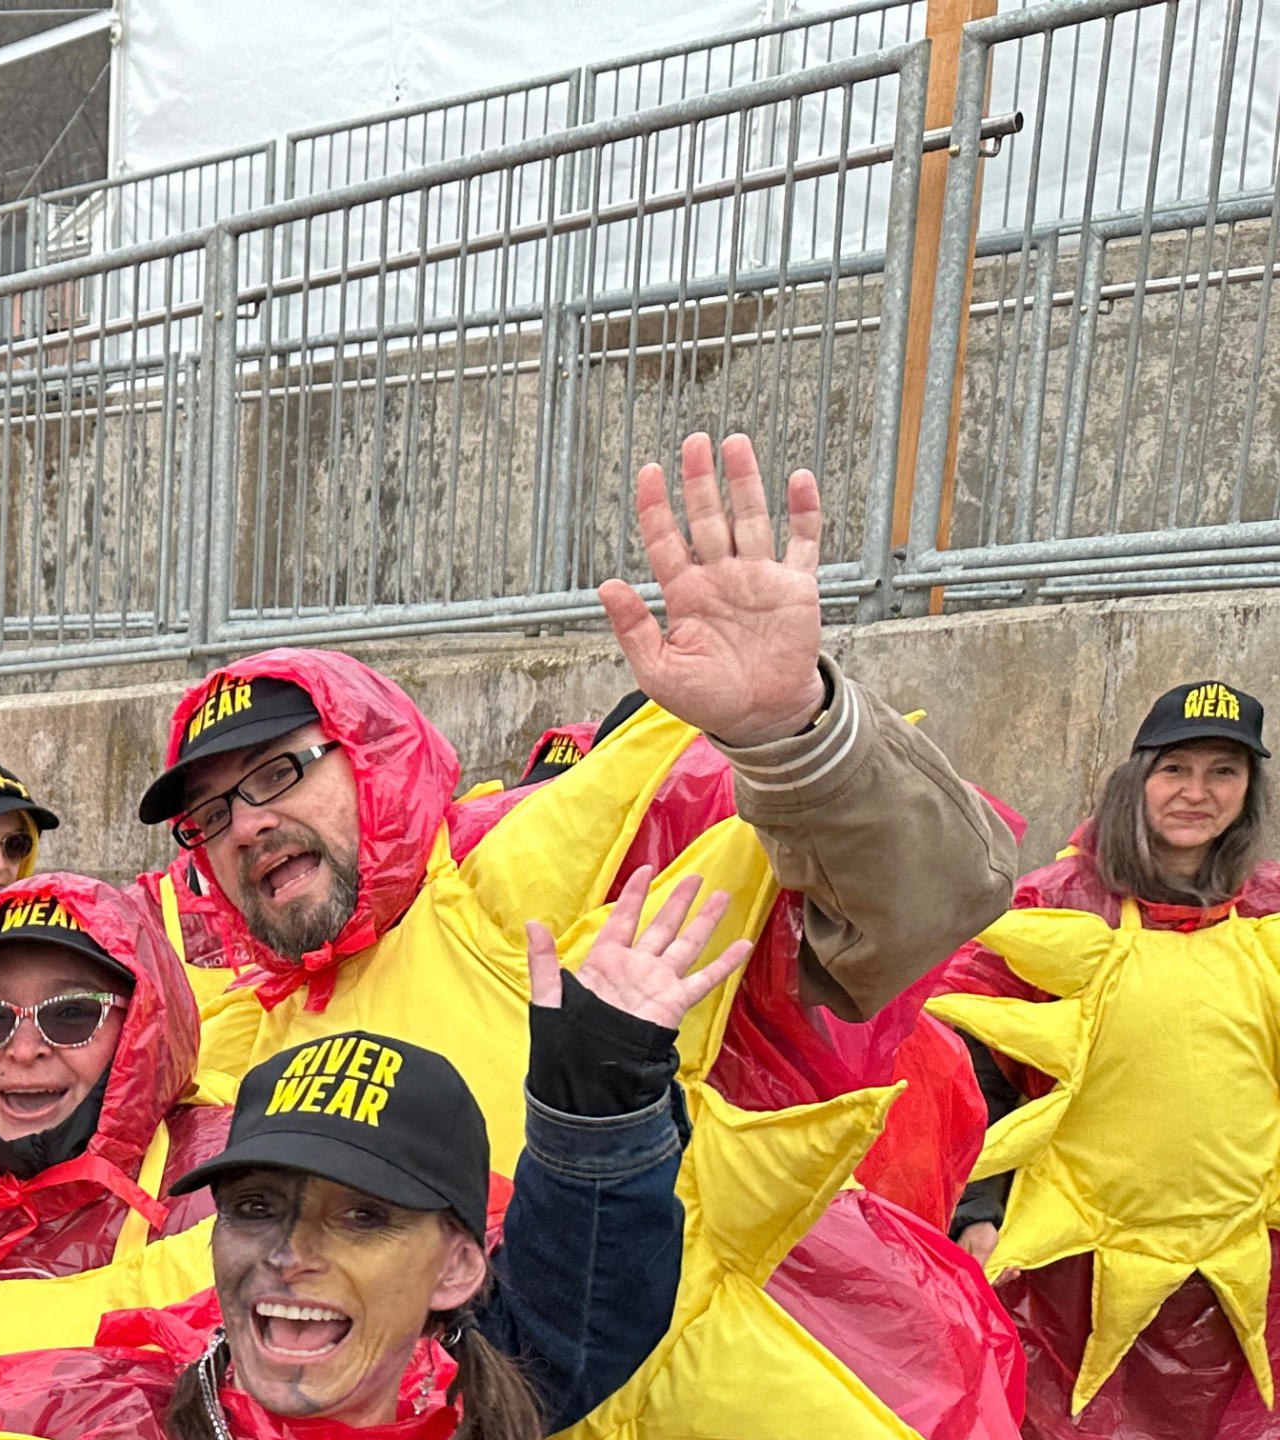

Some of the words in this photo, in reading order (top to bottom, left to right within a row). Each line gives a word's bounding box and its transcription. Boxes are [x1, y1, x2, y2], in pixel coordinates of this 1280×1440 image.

[188, 684, 252, 744] WEAR
[1184, 699, 1240, 721] WEAR
[282, 1037, 403, 1087] RIVER
[265, 1076, 389, 1127] WEAR
